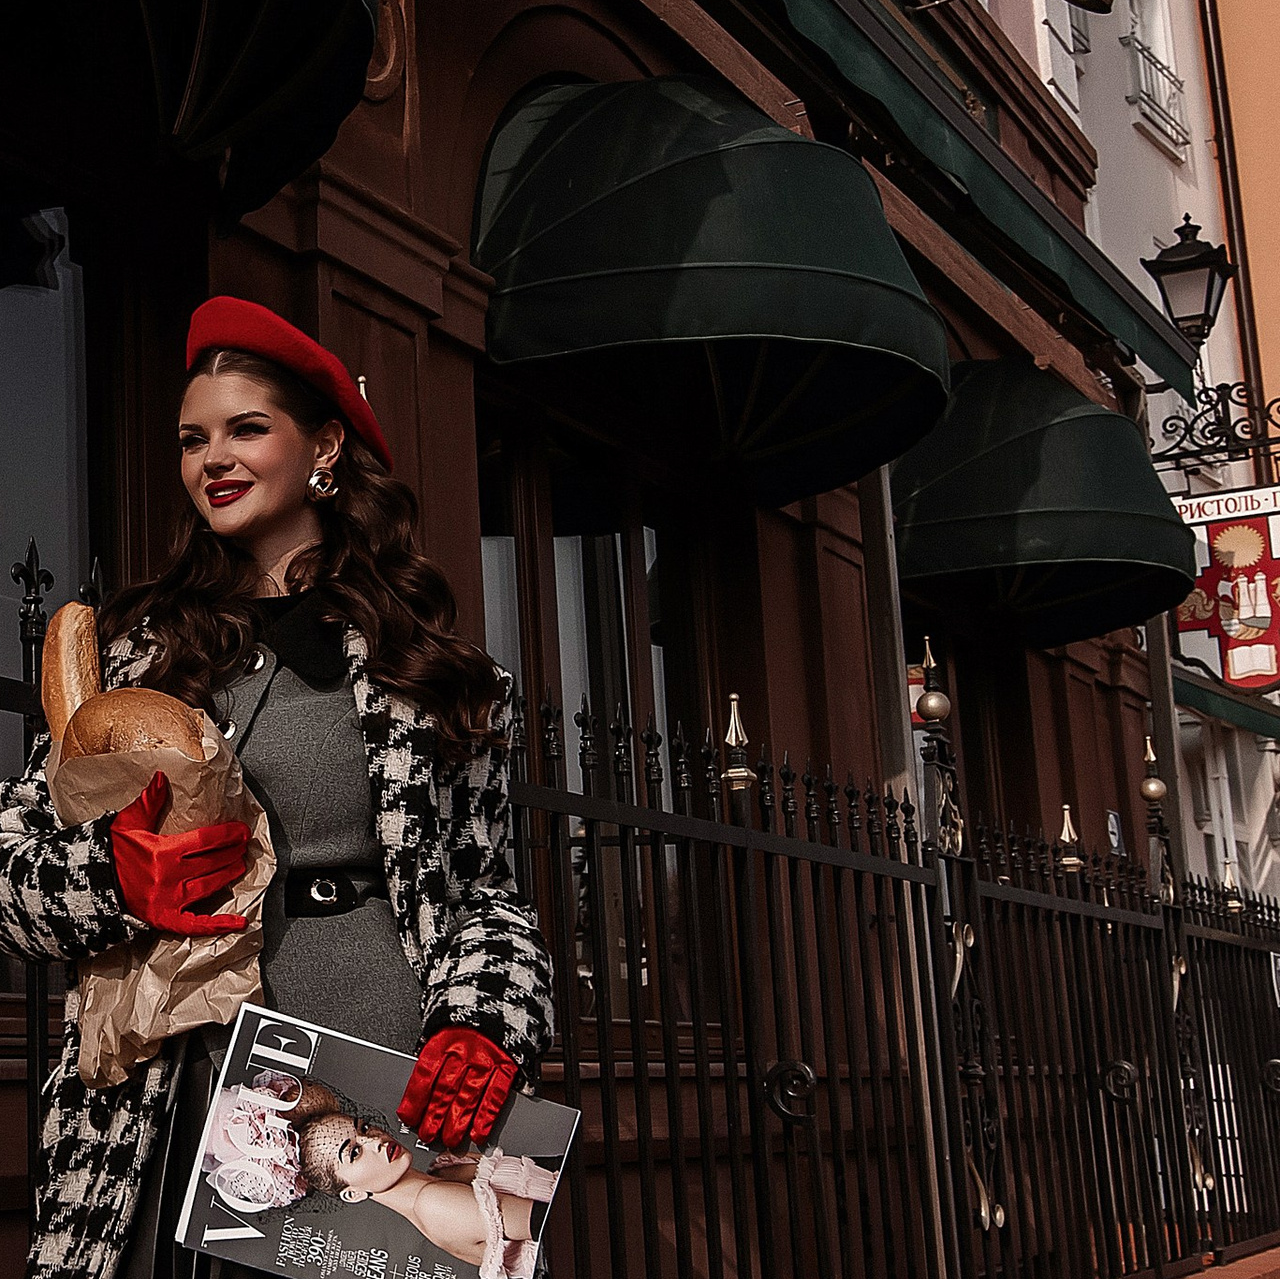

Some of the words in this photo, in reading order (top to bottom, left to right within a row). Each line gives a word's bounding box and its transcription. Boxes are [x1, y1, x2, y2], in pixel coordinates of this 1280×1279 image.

[201, 1017, 319, 1247] VOGUE
[275, 1215, 295, 1267] FASHION
[305, 1230, 326, 1266] 390+
[354, 1249, 370, 1278] SEXIER
